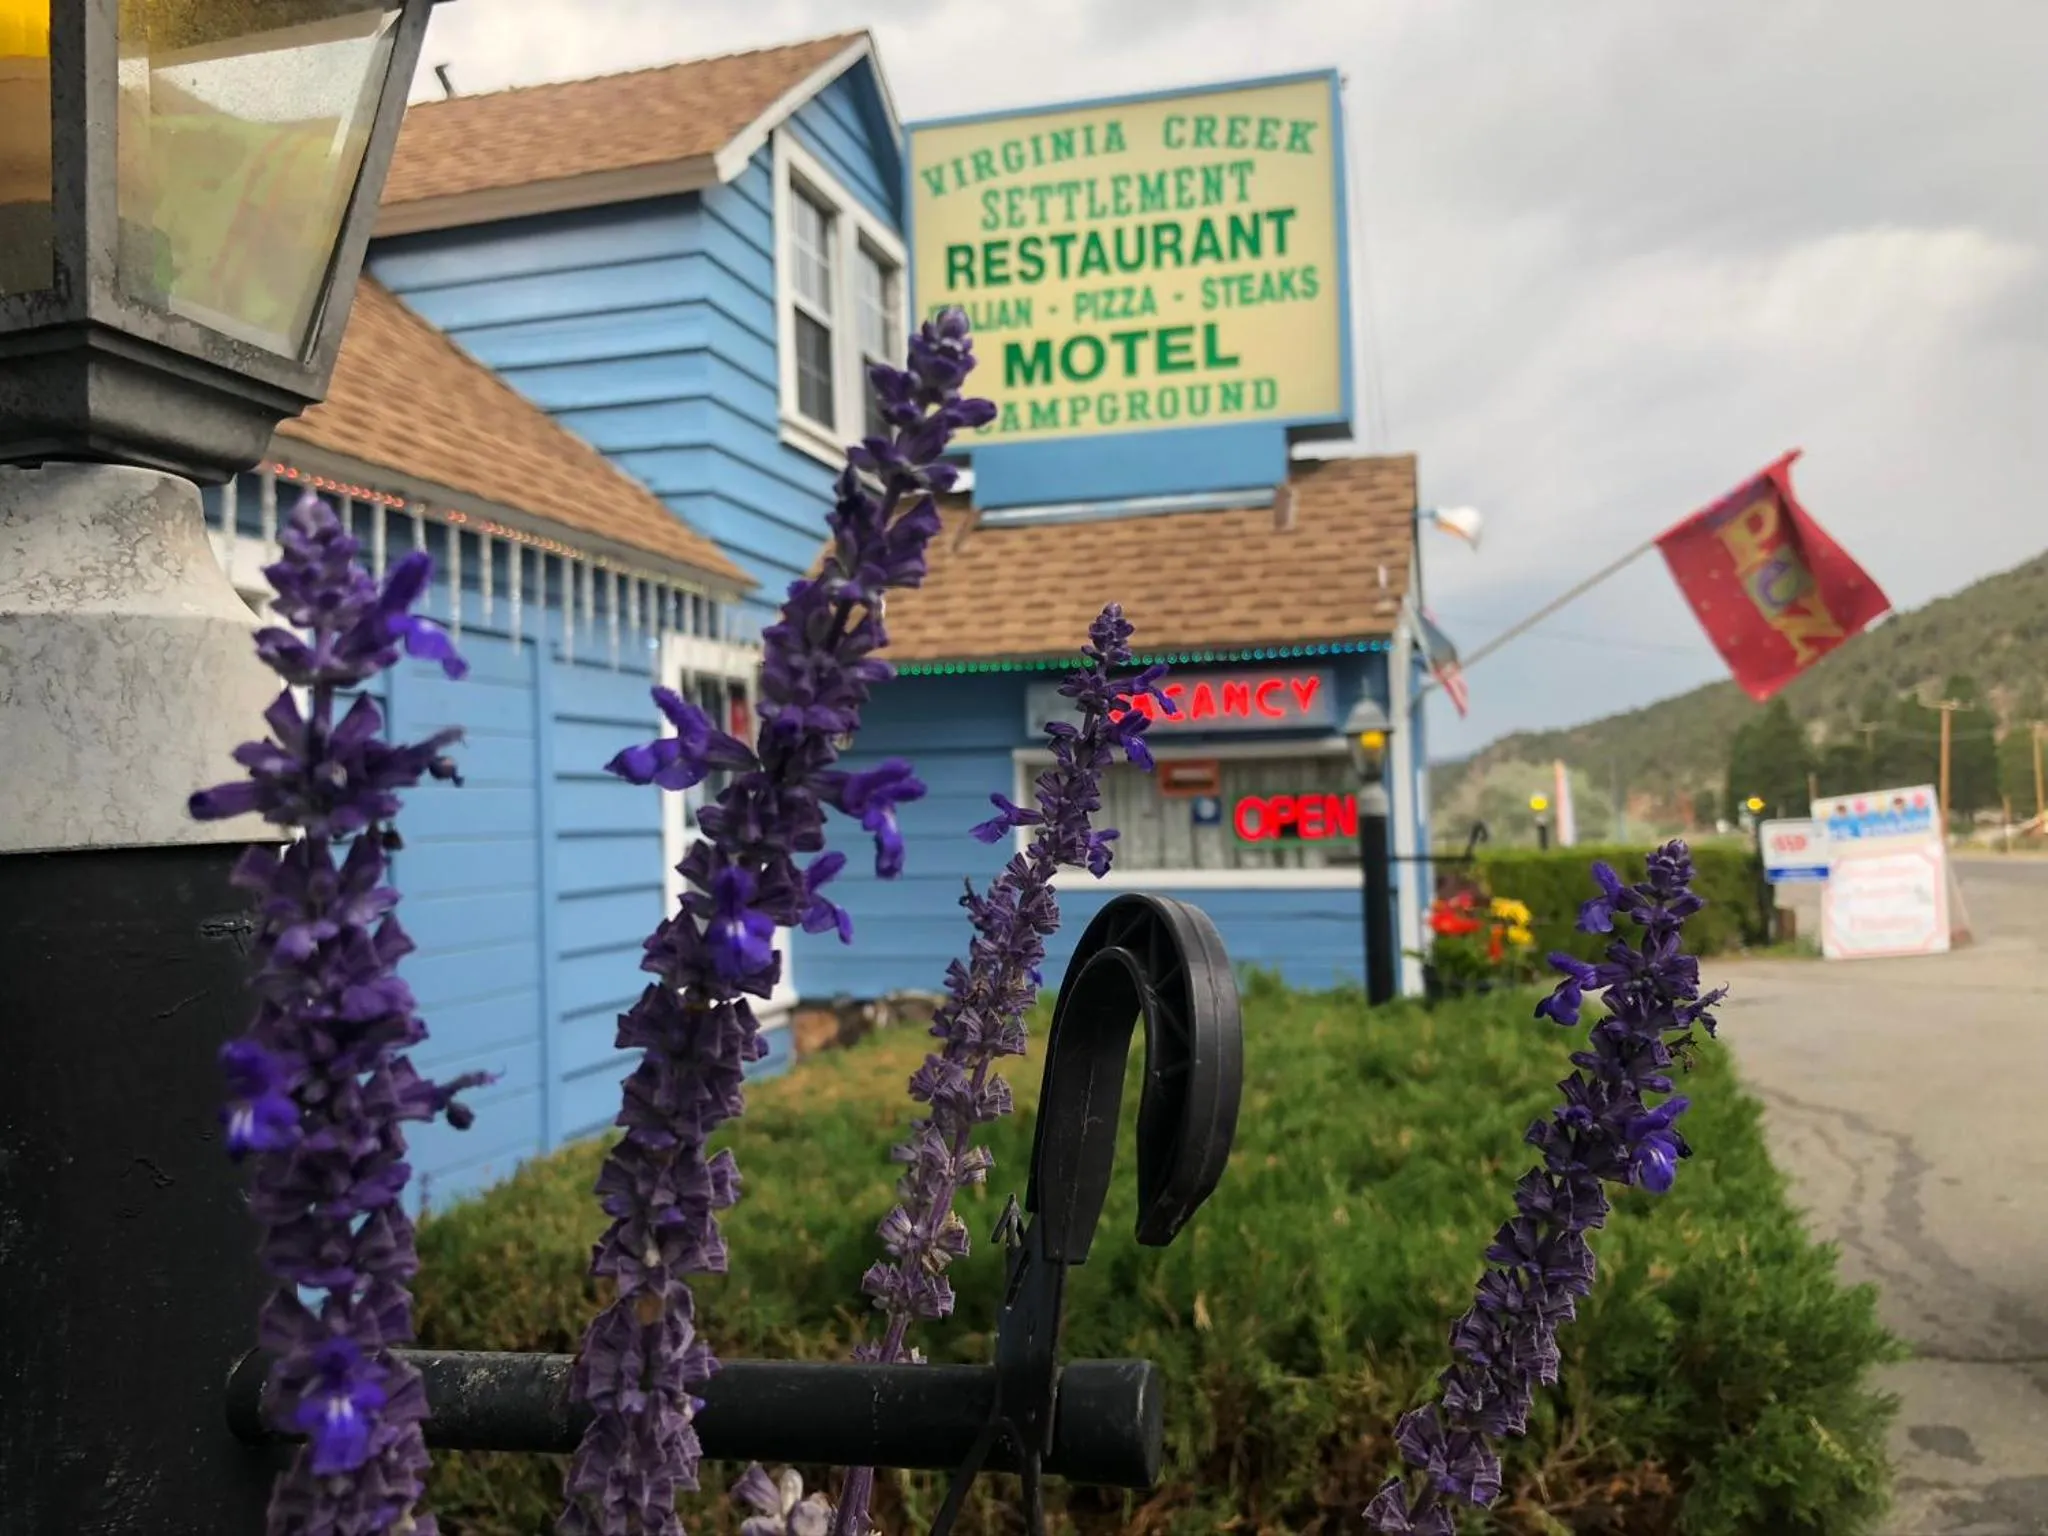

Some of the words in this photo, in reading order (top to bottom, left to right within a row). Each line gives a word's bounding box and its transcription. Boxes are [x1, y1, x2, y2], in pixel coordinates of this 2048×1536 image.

[920, 120, 1128, 199] VIRGINIA
[1161, 114, 1319, 156] CREEK
[980, 160, 1257, 231] SETTLEMENT
[945, 208, 1298, 291] RESTAURANT
[1073, 285, 1158, 324] PIZZA
[1200, 265, 1320, 312] STEAKS
[1003, 323, 1241, 389] MOTEL
[975, 377, 1280, 437] AMPGROUND
[1234, 793, 1358, 842] OPEN
